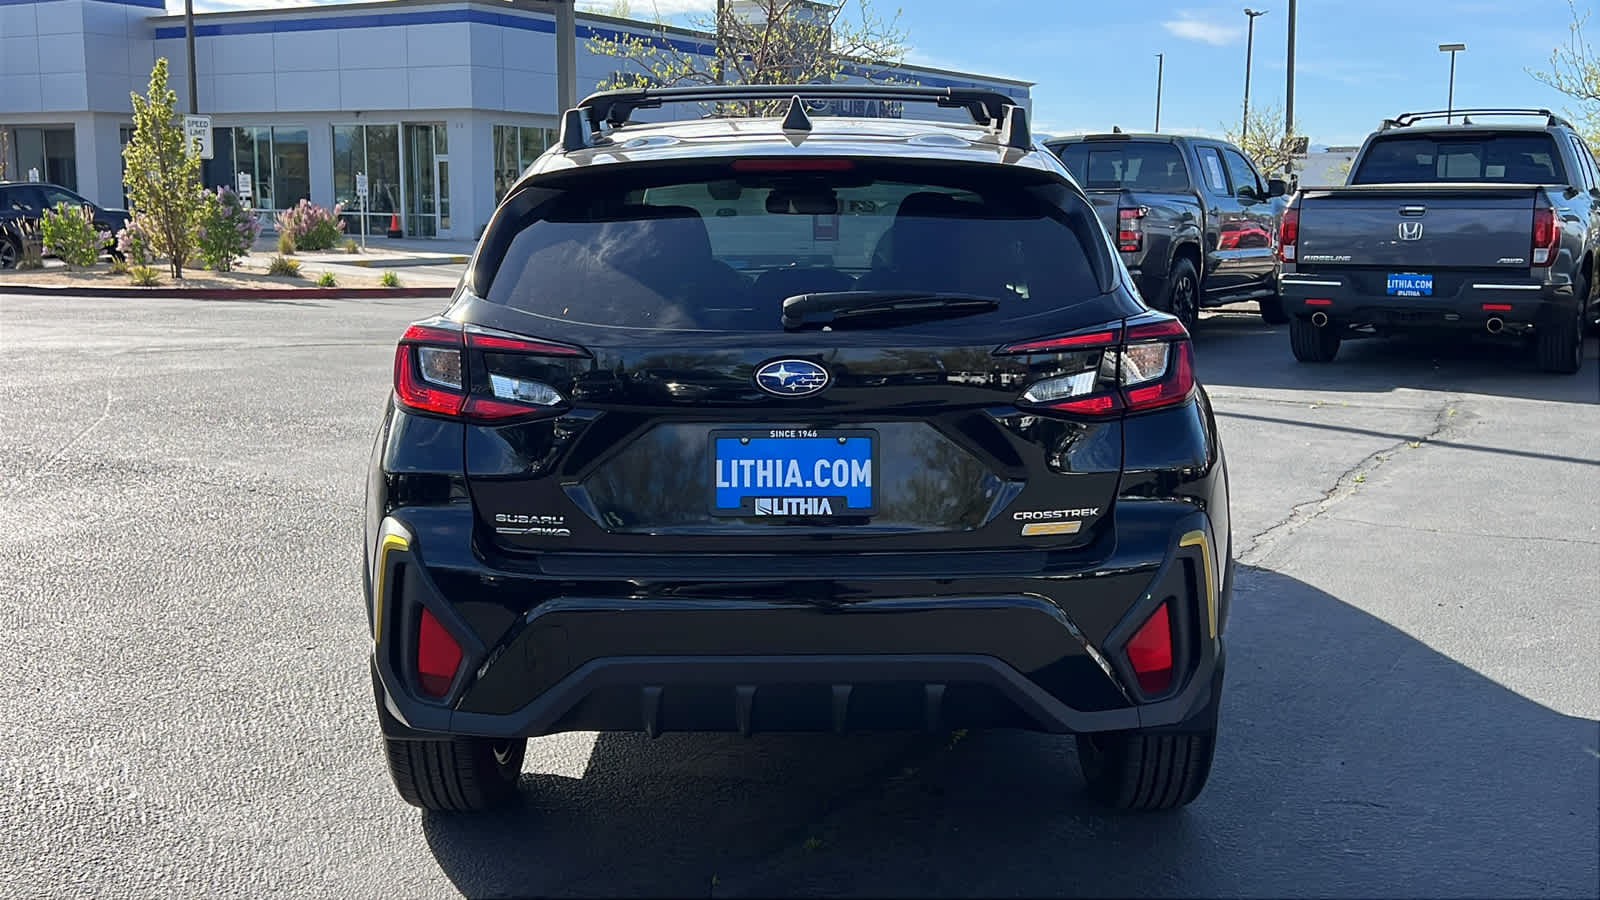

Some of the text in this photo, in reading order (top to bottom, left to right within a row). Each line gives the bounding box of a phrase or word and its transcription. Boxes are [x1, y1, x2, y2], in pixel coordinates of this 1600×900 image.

[187, 120, 209, 128] SPEED
[189, 128, 206, 136] LIMIT
[1387, 279, 1433, 289] LITHIA.COM
[769, 430, 818, 438] SINCE 1946
[716, 459, 872, 488] LITHIA.COM
[773, 498, 832, 515] LITHIA
[1013, 507, 1099, 520] CROSSTREK
[495, 514, 565, 524] SUBARU
